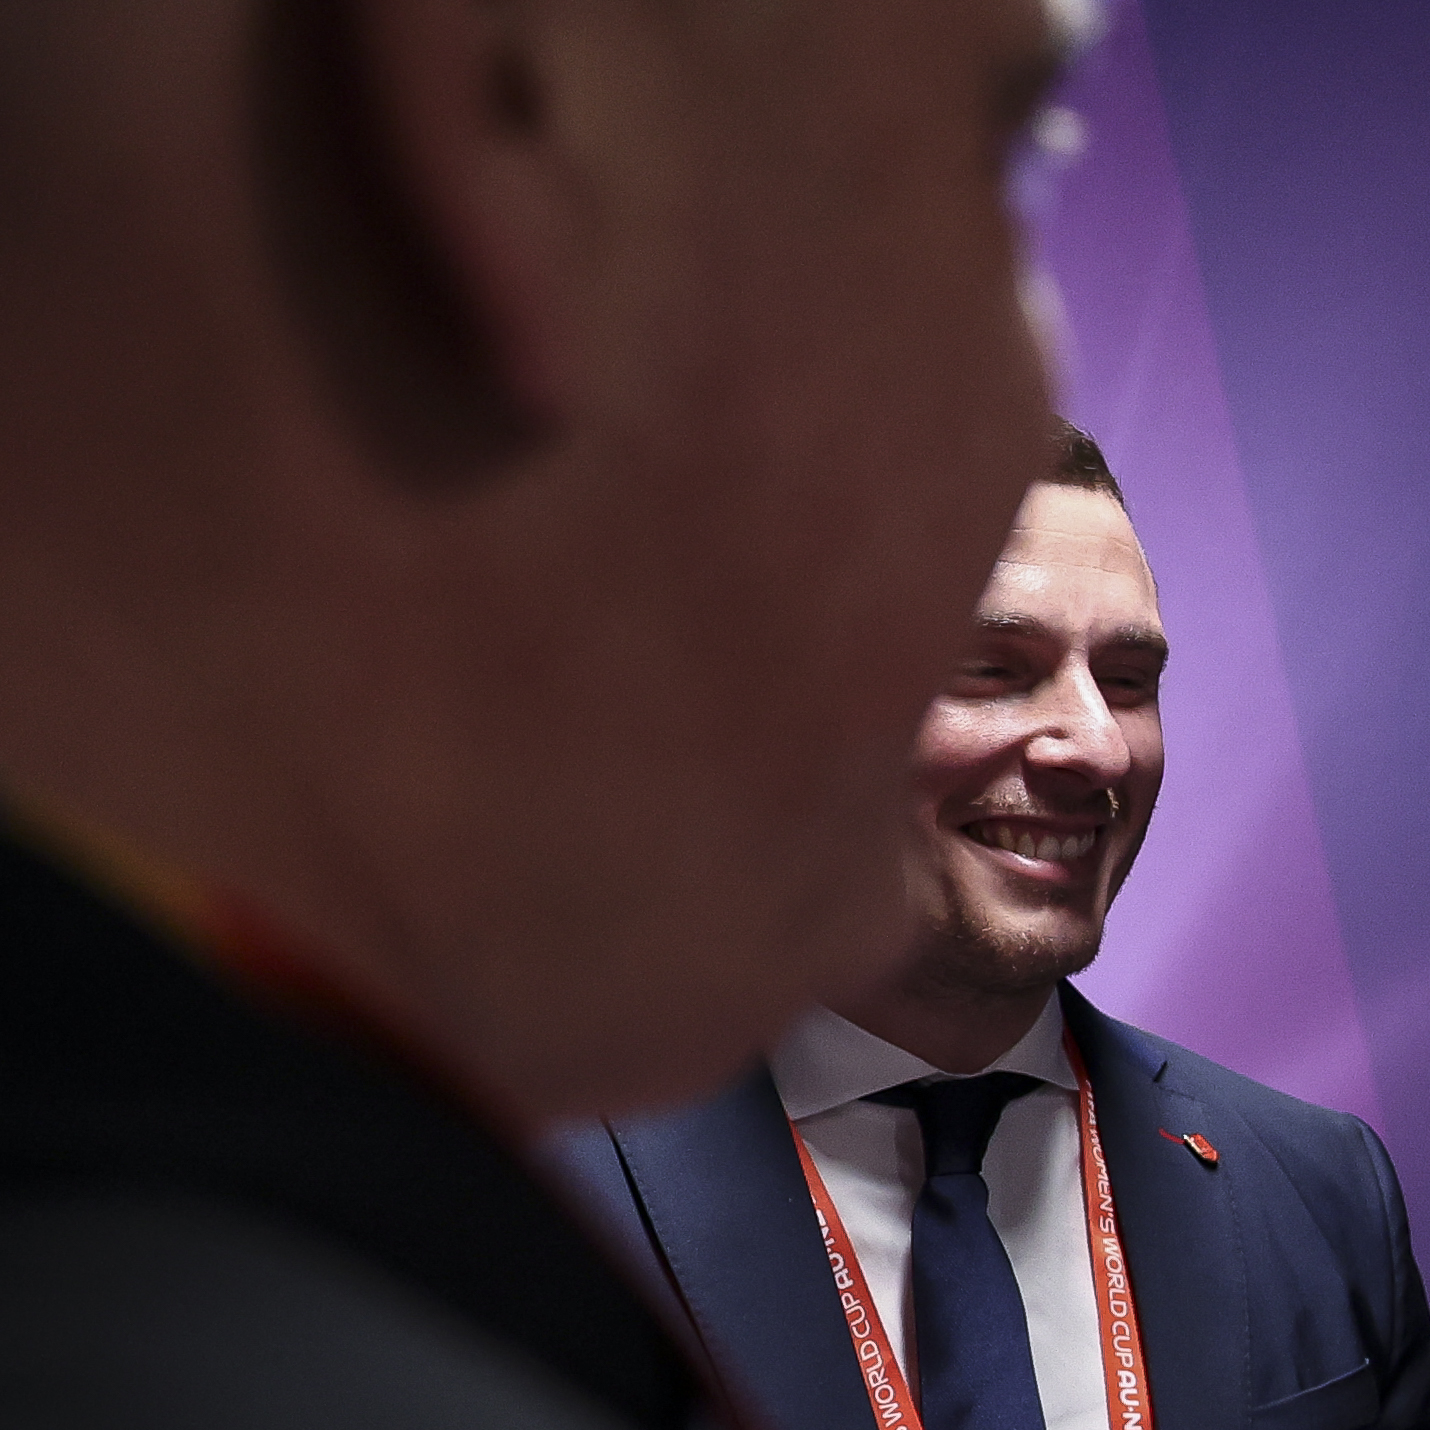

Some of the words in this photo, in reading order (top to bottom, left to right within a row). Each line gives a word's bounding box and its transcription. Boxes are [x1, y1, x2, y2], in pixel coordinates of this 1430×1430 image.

[1089, 1128, 1117, 1235] WOMEN'S
[840, 1292, 871, 1339] CUP
[1102, 1236, 1128, 1319] WORLD
[859, 1339, 903, 1428] WORLD
[1111, 1320, 1134, 1368] CUP
